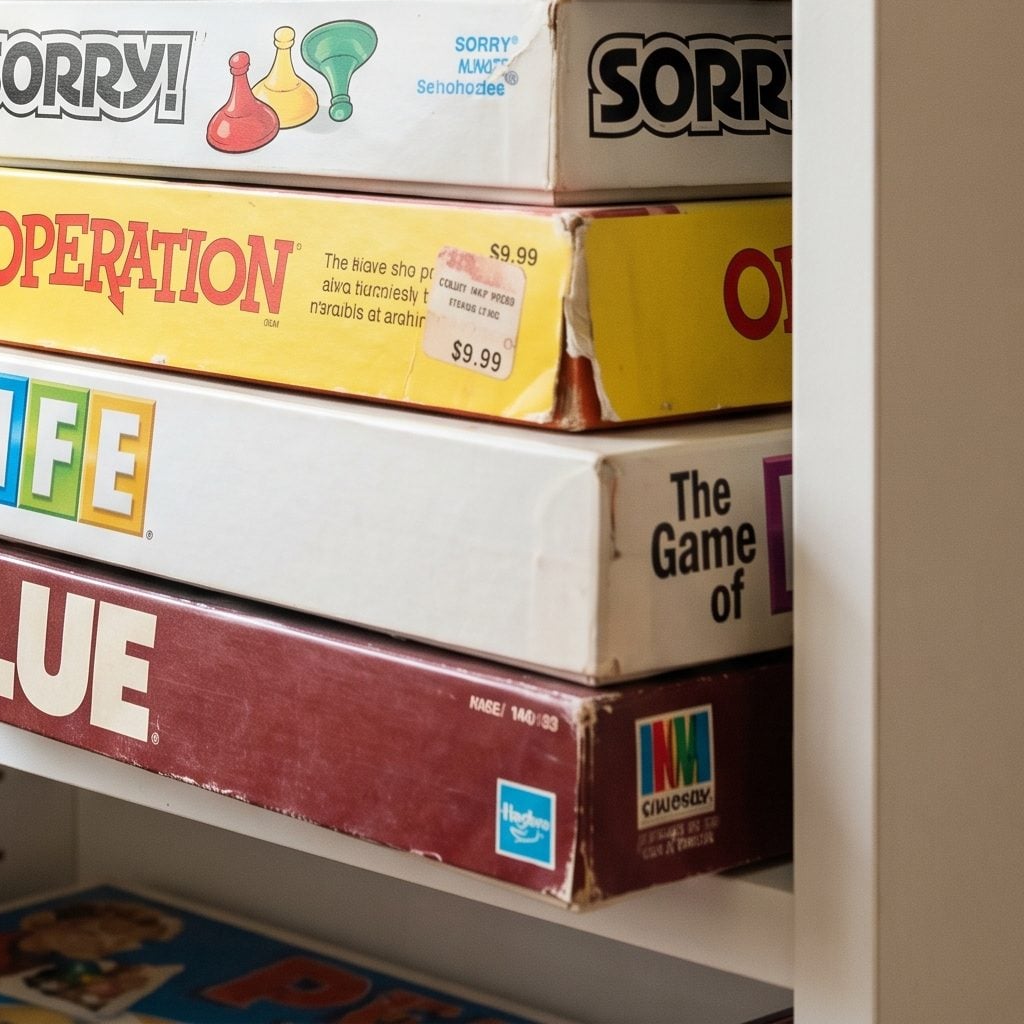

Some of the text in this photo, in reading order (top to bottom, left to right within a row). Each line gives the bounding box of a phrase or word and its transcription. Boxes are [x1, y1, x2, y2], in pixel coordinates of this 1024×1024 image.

[587, 32, 792, 138] SORR
[325, 253, 348, 270] The
[489, 243, 538, 266] $9.99
[451, 340, 501, 372] $9.99
[670, 469, 731, 522] The
[651, 522, 756, 579] Game
[711, 568, 744, 623] of
